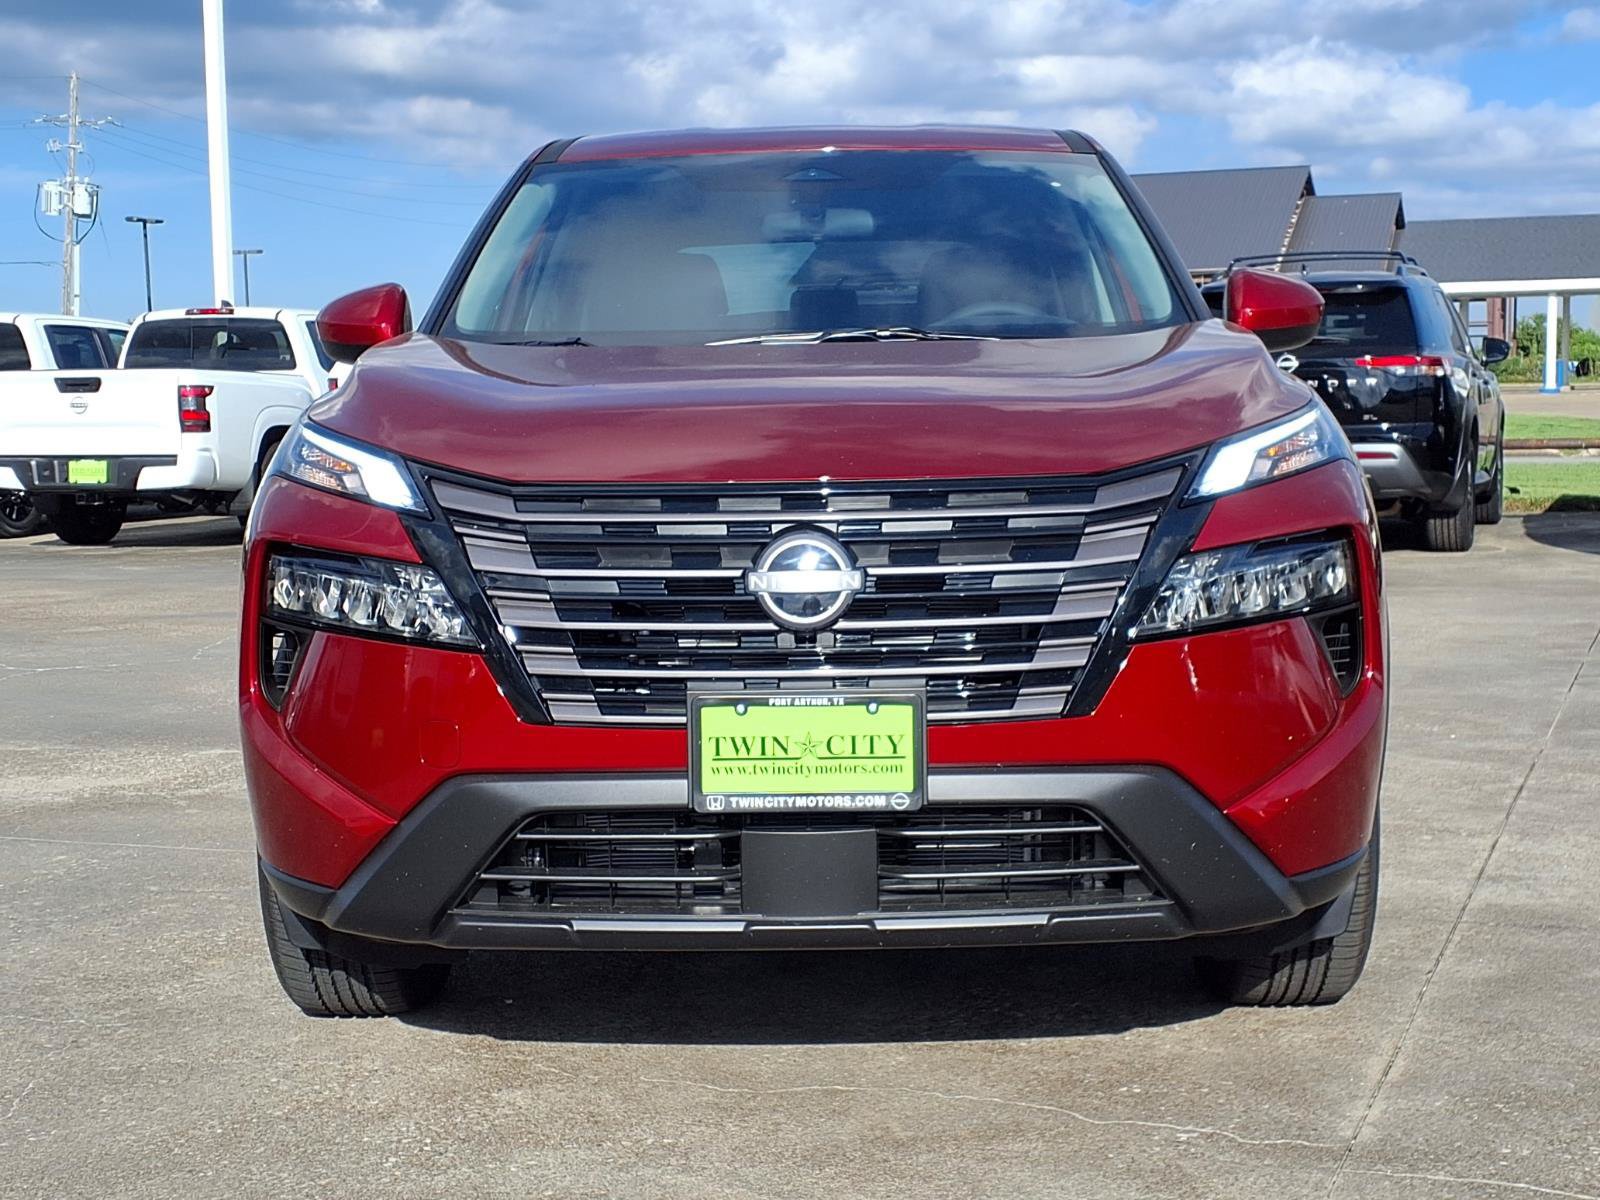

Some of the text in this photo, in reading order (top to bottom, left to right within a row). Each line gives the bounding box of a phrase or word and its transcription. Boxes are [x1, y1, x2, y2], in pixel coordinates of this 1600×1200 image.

[750, 574, 860, 591] NIN
[768, 697, 845, 706] PORT ARTHUR, TX
[708, 733, 905, 758] TWIN CITY
[709, 761, 904, 778] www.twincitymotors.com
[730, 795, 887, 809] TWINCITYMOTORS.COM
